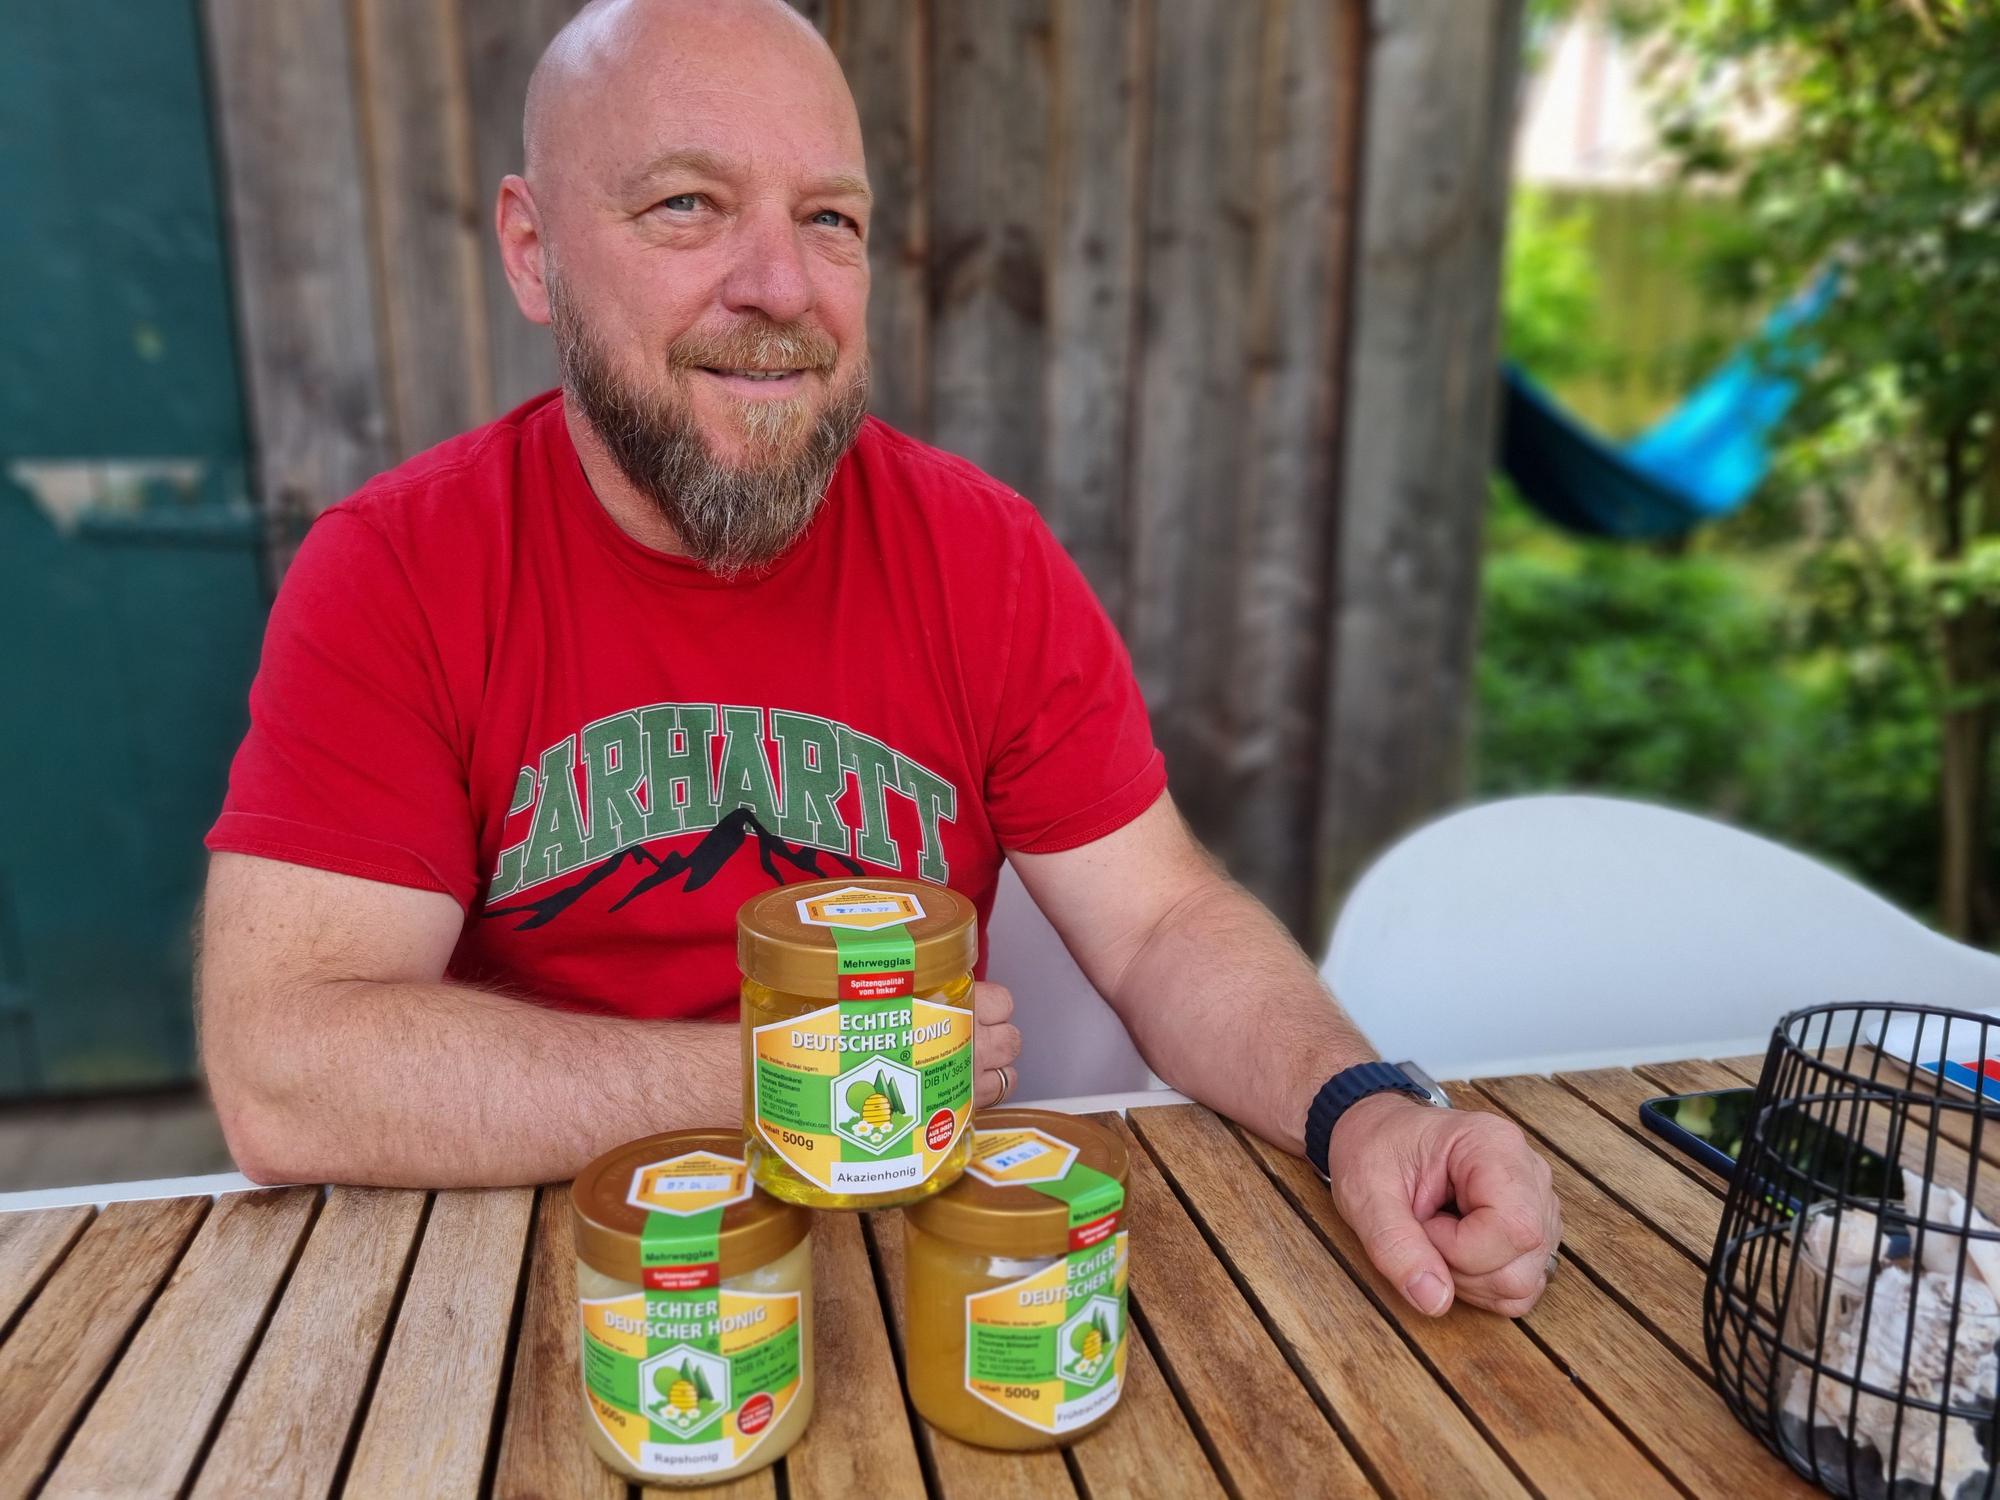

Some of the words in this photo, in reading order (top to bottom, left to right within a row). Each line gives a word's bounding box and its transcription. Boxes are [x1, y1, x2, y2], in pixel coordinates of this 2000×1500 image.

[843, 957, 911, 969] Mehrwegglas
[850, 977, 905, 988] Spitzenqualität
[859, 988, 874, 996] vom
[876, 986, 897, 995] Imker
[839, 1008, 911, 1031] ECHTER
[791, 1029, 899, 1053] DEUTSCHER
[902, 1018, 951, 1046] HONIG
[924, 1075, 940, 1089] DIB
[782, 1131, 814, 1150] 500g
[929, 1129, 953, 1146] REGION
[837, 1166, 917, 1184] Akazienhonig
[1067, 1245, 1116, 1280] ECHTER
[1018, 1272, 1107, 1307] DEUTSCHER
[645, 1299, 719, 1320] ECHTER
[603, 1309, 703, 1341] DEUTSCHER
[707, 1304, 768, 1336] HONIG
[1004, 1386, 1041, 1401] 500g
[653, 1452, 720, 1467] Rapshonig
